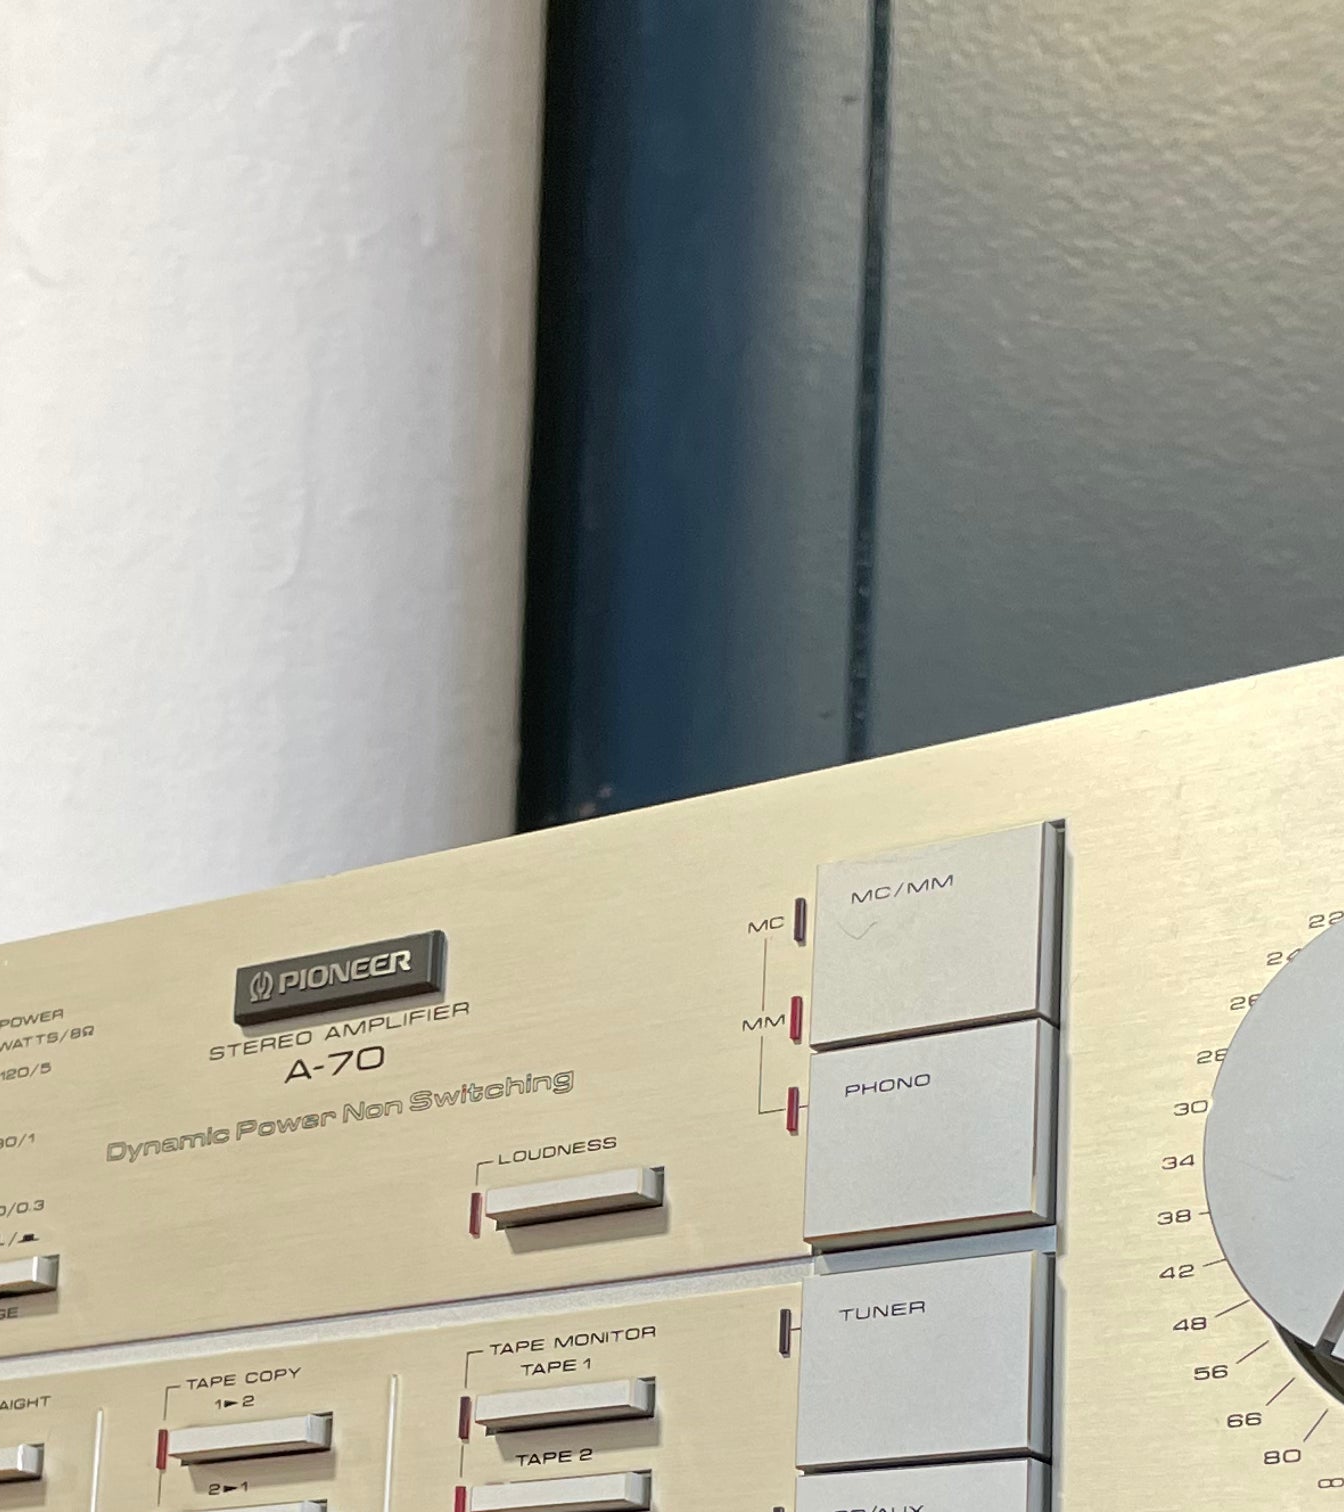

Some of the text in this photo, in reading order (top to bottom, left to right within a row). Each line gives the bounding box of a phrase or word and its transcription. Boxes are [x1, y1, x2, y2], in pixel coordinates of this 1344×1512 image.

[850, 874, 955, 905] MC/MM
[747, 915, 785, 935] MC
[278, 949, 411, 994] PIONEER
[209, 1001, 470, 1062] STEREO AMPLIFIER
[742, 1013, 786, 1031] MM
[0, 1062, 51, 1082] 120/5
[284, 1045, 385, 1084] A-70
[844, 1074, 931, 1097] PHONO
[106, 1070, 575, 1163] Dynamic Power Non Switching
[1174, 1100, 1208, 1116] 30
[498, 1136, 618, 1165] LOUDNESS
[1162, 1154, 1195, 1170] 34
[1158, 1209, 1191, 1225] 38
[1159, 1264, 1194, 1280] 42
[839, 1300, 925, 1322] TUNER
[1173, 1317, 1207, 1333] 48
[490, 1325, 656, 1356] TAPE MONITOR
[520, 1358, 592, 1377] TAPE 1
[1194, 1365, 1228, 1381] 56
[186, 1367, 301, 1391] TAPE COPY
[1227, 1413, 1262, 1428] 66
[516, 1448, 593, 1468] TAPE 2
[1264, 1449, 1301, 1466] 80
